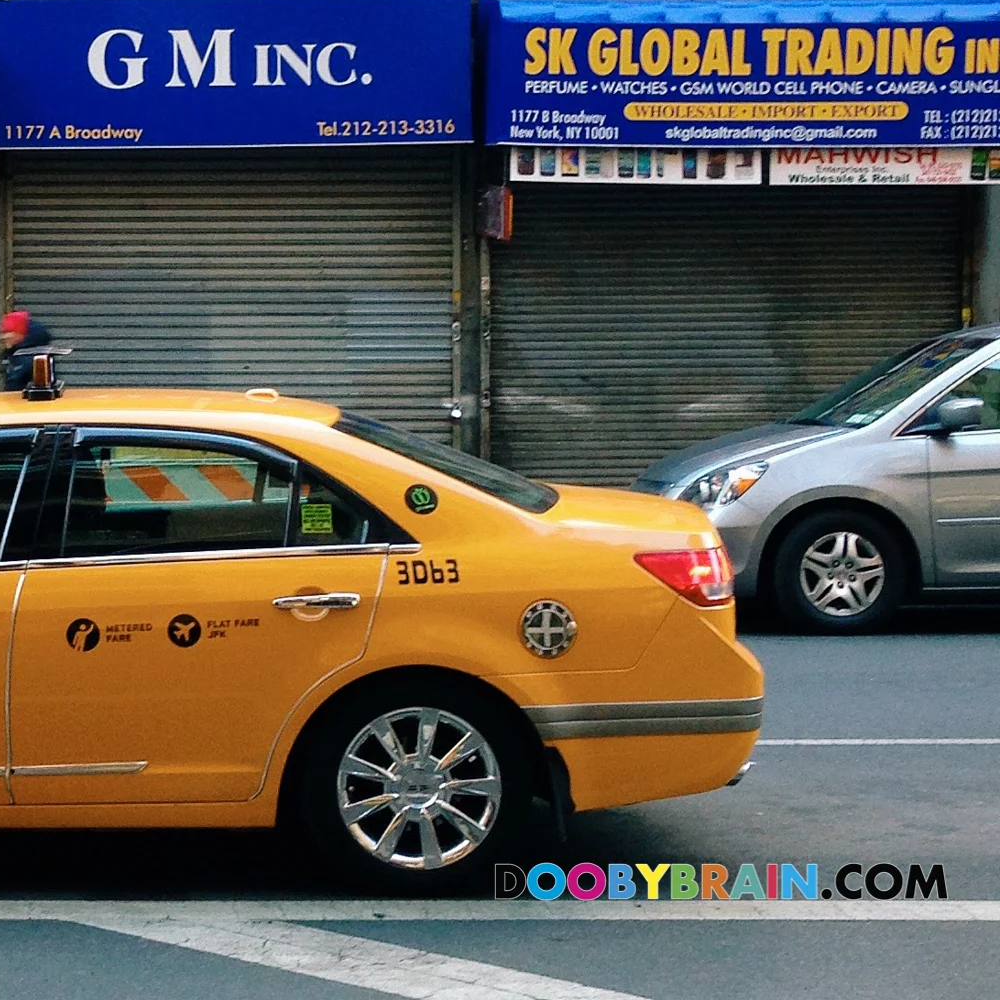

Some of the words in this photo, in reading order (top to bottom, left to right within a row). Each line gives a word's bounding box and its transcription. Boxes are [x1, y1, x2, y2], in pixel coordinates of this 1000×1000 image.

[523, 27, 578, 76] SK
[587, 27, 752, 77] GLOBAL
[761, 25, 955, 77] TRADING
[86, 28, 149, 90] G
[165, 28, 236, 88] M
[252, 42, 374, 87] INC.
[524, 80, 589, 95] PERFUME
[600, 81, 668, 96] WATCHES
[679, 81, 713, 96] GSM
[717, 81, 771, 96] WORLD
[774, 81, 807, 95] CELL
[810, 81, 864, 96] PHONE
[875, 80, 938, 95] CAMERA
[510, 109, 540, 124] 1177
[542, 109, 550, 124] B
[552, 109, 607, 127] Broadway
[634, 105, 738, 119] WHOLESALE
[752, 104, 817, 119] IMPORT
[831, 104, 900, 118] EXPORT
[950, 109, 1000, 124] (212)21
[5, 125, 45, 140] 1177
[49, 125, 61, 140] A
[65, 125, 143, 142] Broadway
[510, 125, 535, 139] New
[536, 125, 564, 142] York,
[566, 125, 583, 140] NY
[585, 125, 620, 140] 10001
[665, 125, 877, 142] skglobaltradinginc@gmail.com
[950, 125, 1000, 140] (212)21
[776, 147, 939, 164] MAHWISH
[787, 173, 854, 183] Wholesale
[872, 173, 910, 183] Retail
[105, 623, 153, 633] METERED
[206, 620, 230, 629] FLAT
[234, 618, 260, 628] FARE
[105, 634, 132, 643] FARE
[207, 630, 227, 639] JFK
